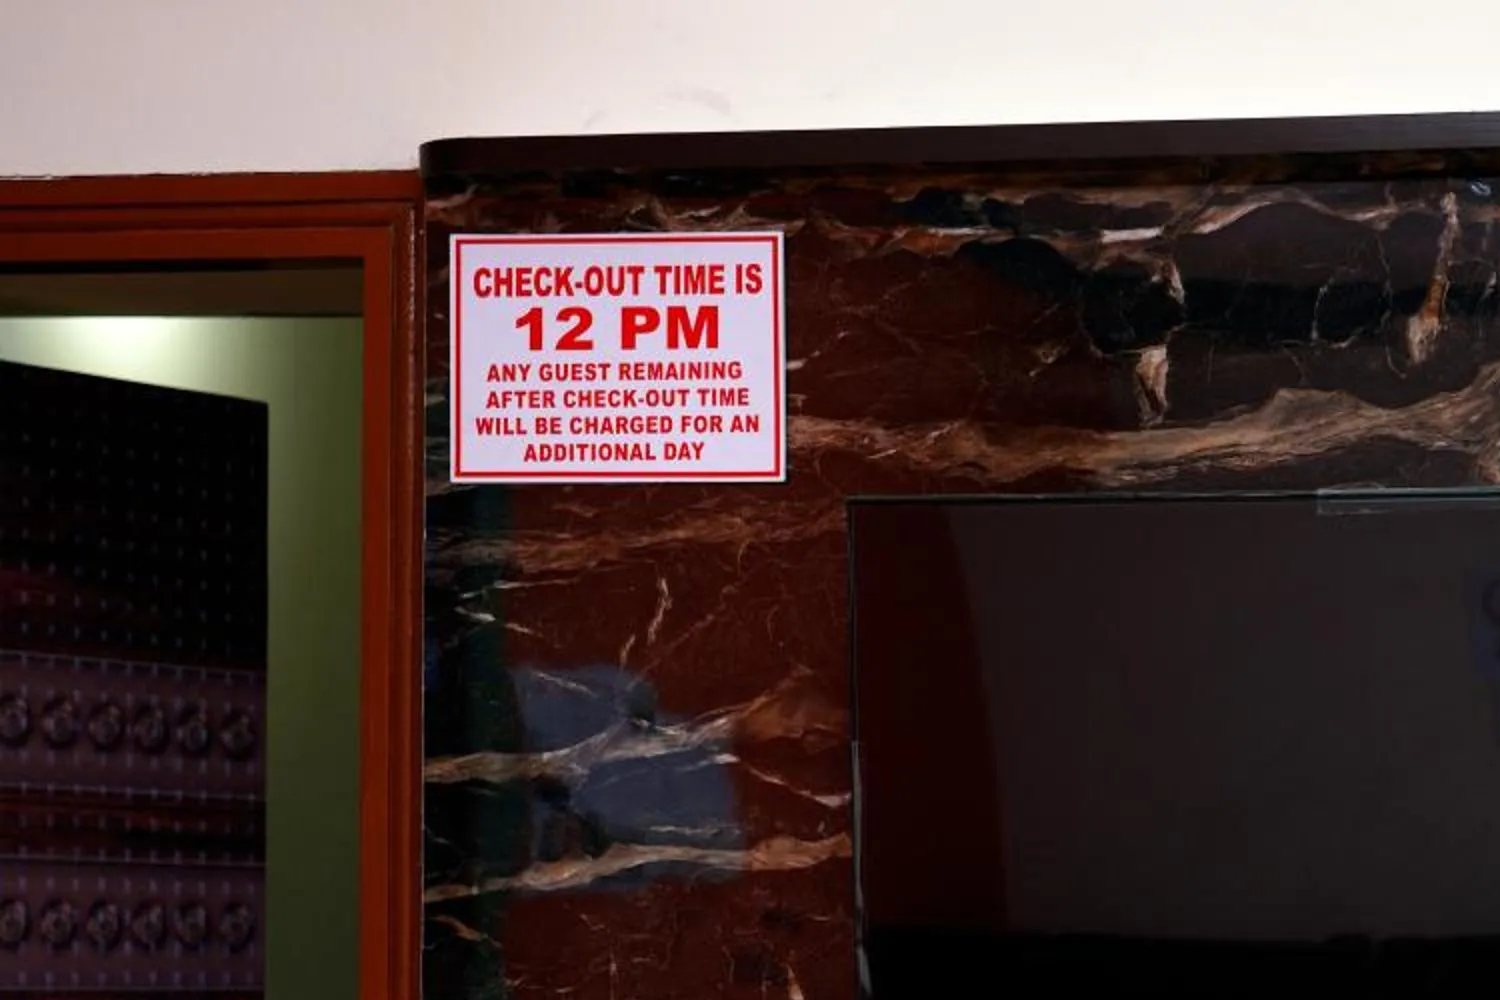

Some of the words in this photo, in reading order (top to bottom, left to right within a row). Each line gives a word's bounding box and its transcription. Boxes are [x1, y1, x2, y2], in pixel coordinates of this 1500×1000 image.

[473, 263, 645, 299] CHECK-OUT
[652, 262, 726, 297] TIME
[734, 262, 764, 296] IS
[515, 305, 596, 354] 12
[618, 303, 721, 352] PM
[486, 363, 531, 383] ANY
[538, 362, 612, 384] GUEST
[617, 360, 743, 383] REMAINING
[485, 389, 557, 409] AFTER
[563, 387, 691, 410] CHECK-OUT
[696, 386, 749, 407] TIME
[474, 416, 527, 438] WILL
[534, 416, 562, 437] BE
[568, 414, 674, 436] CHARGED
[679, 414, 724, 434] FOR
[730, 415, 760, 434] AN
[523, 442, 656, 463] ADDITIONAL
[662, 440, 704, 461] DAY
